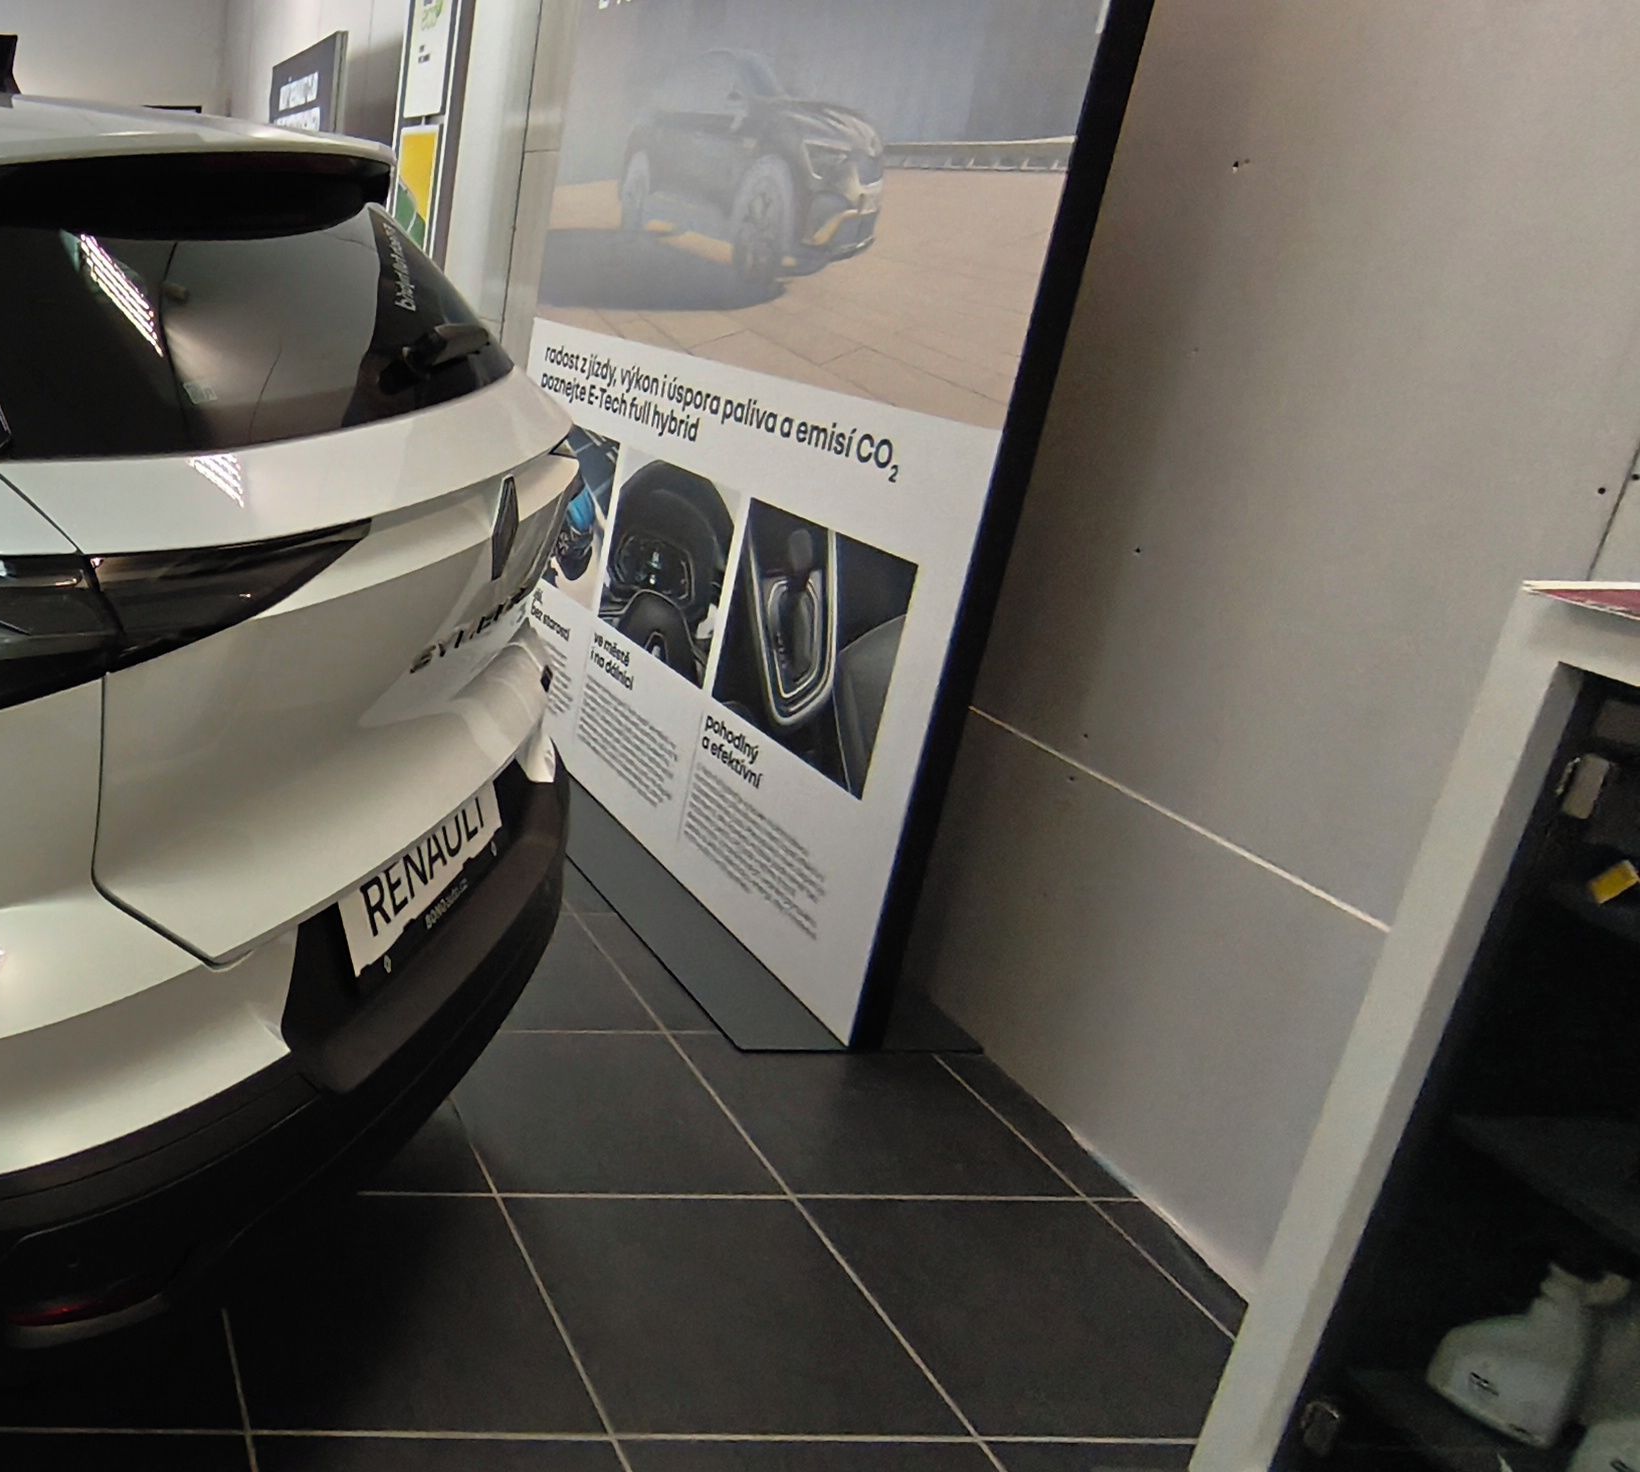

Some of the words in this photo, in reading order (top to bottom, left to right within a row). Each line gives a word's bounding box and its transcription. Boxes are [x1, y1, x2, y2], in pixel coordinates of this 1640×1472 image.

[541, 373, 586, 404] poznejte
[587, 384, 627, 417] E-Tech
[628, 396, 651, 425] full
[650, 404, 700, 442] hybrid
[545, 345, 580, 371] radost
[580, 356, 587, 374] z
[586, 354, 617, 388] jízdy,
[620, 365, 659, 396] výkon
[660, 374, 667, 397] i
[667, 376, 721, 415] úspora
[721, 399, 778, 433] paliva
[780, 416, 794, 438] a
[796, 421, 858, 458] emisí
[702, 736, 710, 750] a
[710, 742, 763, 789] efektivní
[704, 715, 759, 765] pohodlný
